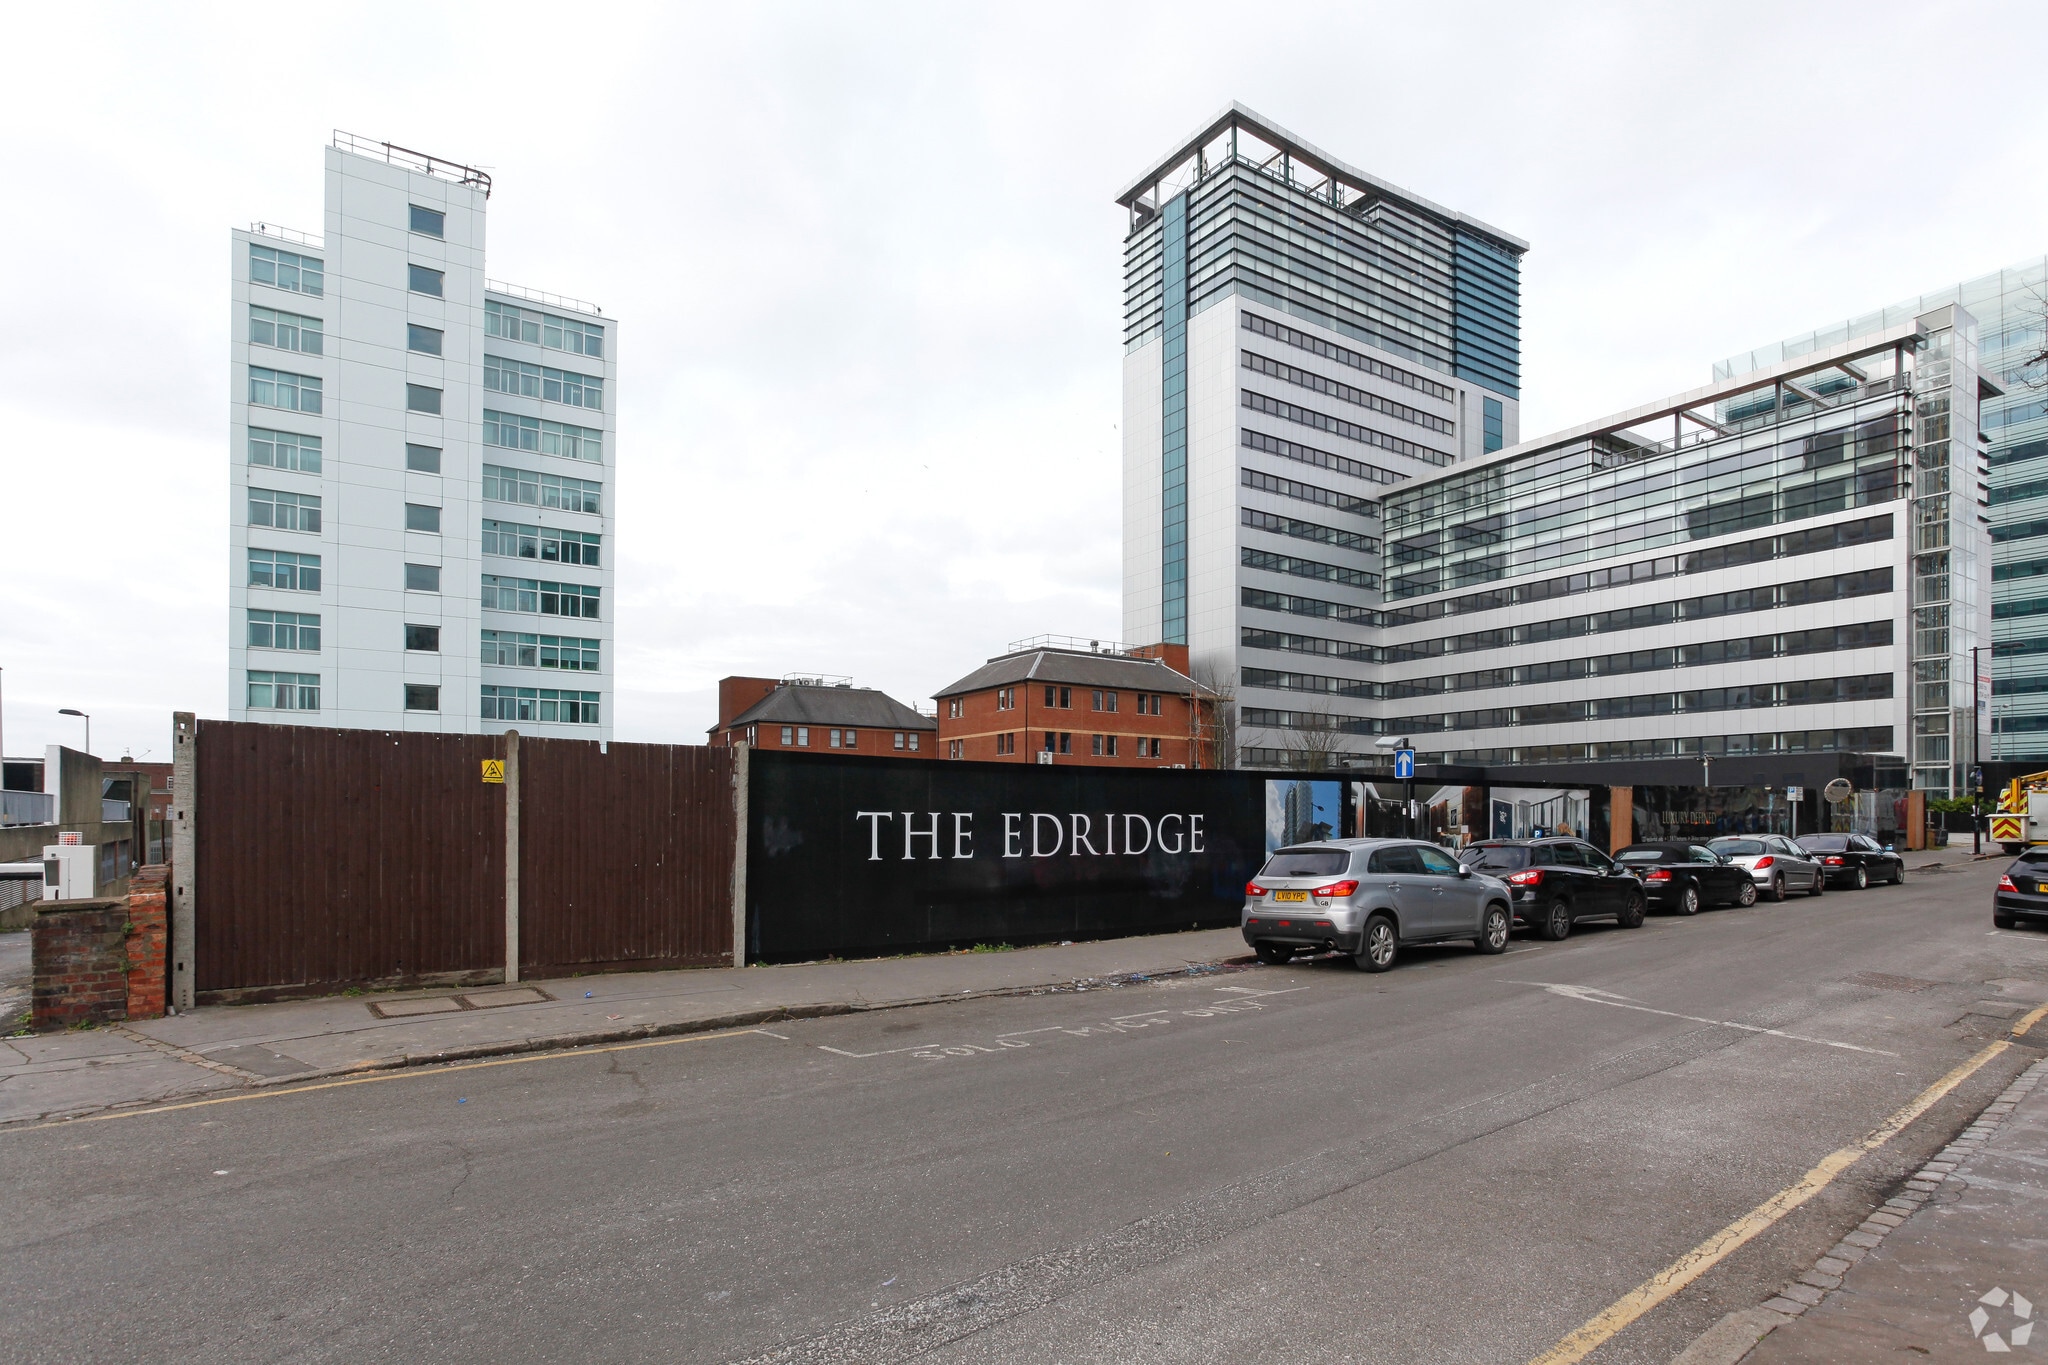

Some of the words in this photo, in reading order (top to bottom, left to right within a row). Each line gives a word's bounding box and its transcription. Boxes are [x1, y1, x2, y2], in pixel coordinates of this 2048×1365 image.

[856, 811, 975, 862] THE
[1001, 812, 1206, 859] EDRIDGE
[1662, 811, 1689, 825] LUXURY
[1690, 811, 1717, 825] DEFINED
[910, 1039, 1031, 1061] SOLO
[1182, 1000, 1269, 1017] ONLY
